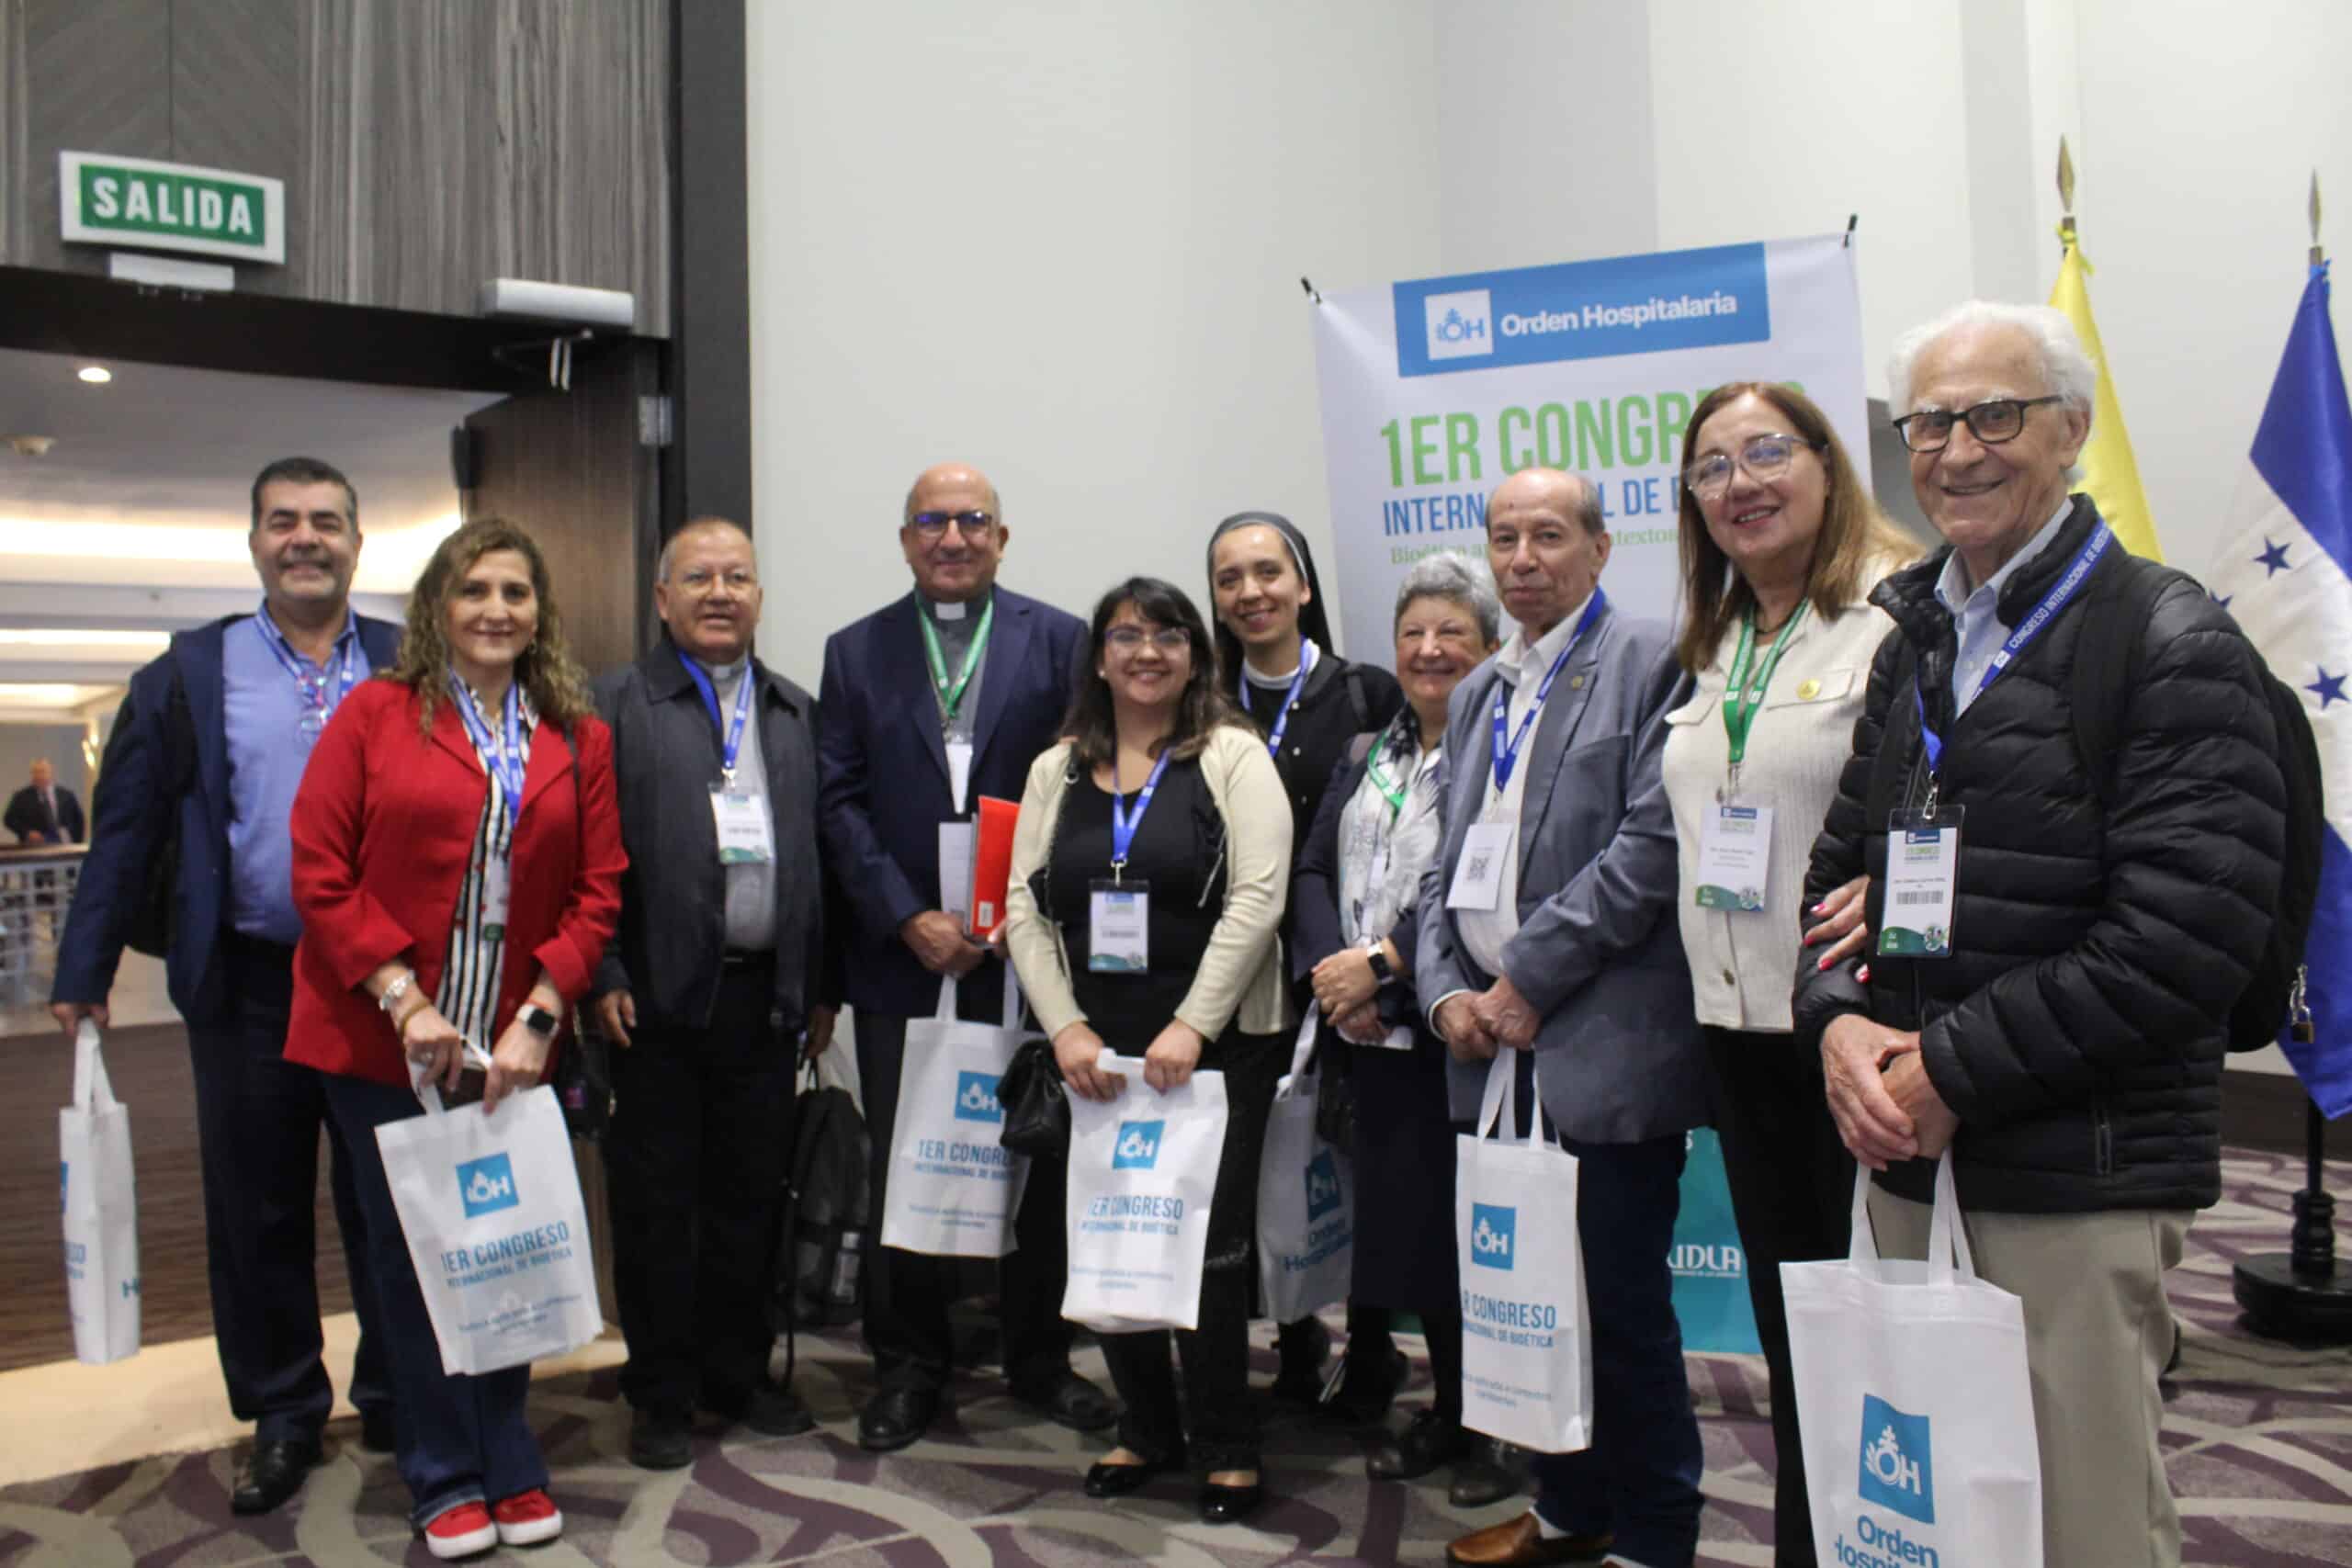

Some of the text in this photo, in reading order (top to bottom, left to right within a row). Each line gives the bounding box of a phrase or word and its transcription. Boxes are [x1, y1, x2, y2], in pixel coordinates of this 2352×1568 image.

[94, 176, 253, 235] SALIDA
[1500, 291, 1737, 336] Orden Hospitalaria
[1381, 412, 1482, 488] 1ER
[1623, 478, 1661, 516] DE
[474, 1220, 570, 1267] CONGRESO
[1472, 1294, 1556, 1330] CONGRESO
[1858, 1515, 1939, 1568] Orden
